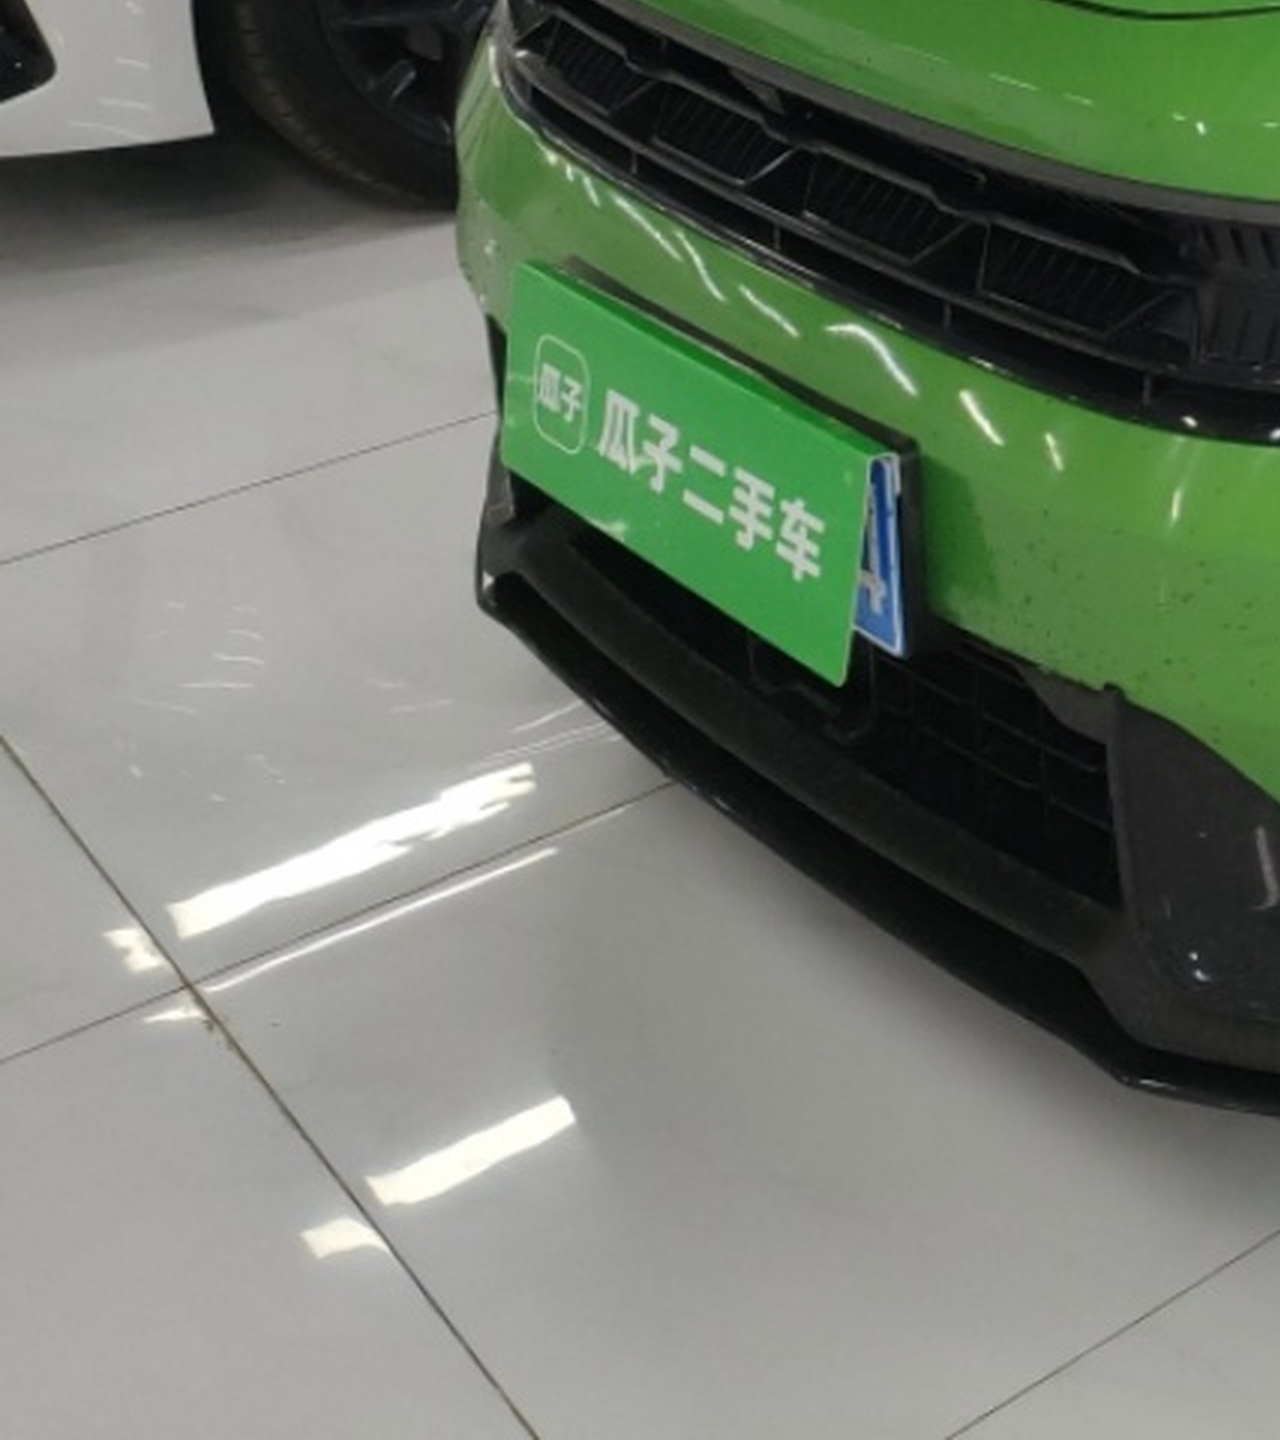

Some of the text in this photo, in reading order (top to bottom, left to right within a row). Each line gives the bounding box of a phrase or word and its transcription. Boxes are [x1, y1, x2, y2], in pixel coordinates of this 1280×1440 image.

[539, 363, 583, 422] 瓜子
[597, 389, 825, 582] 瓜子二手车
